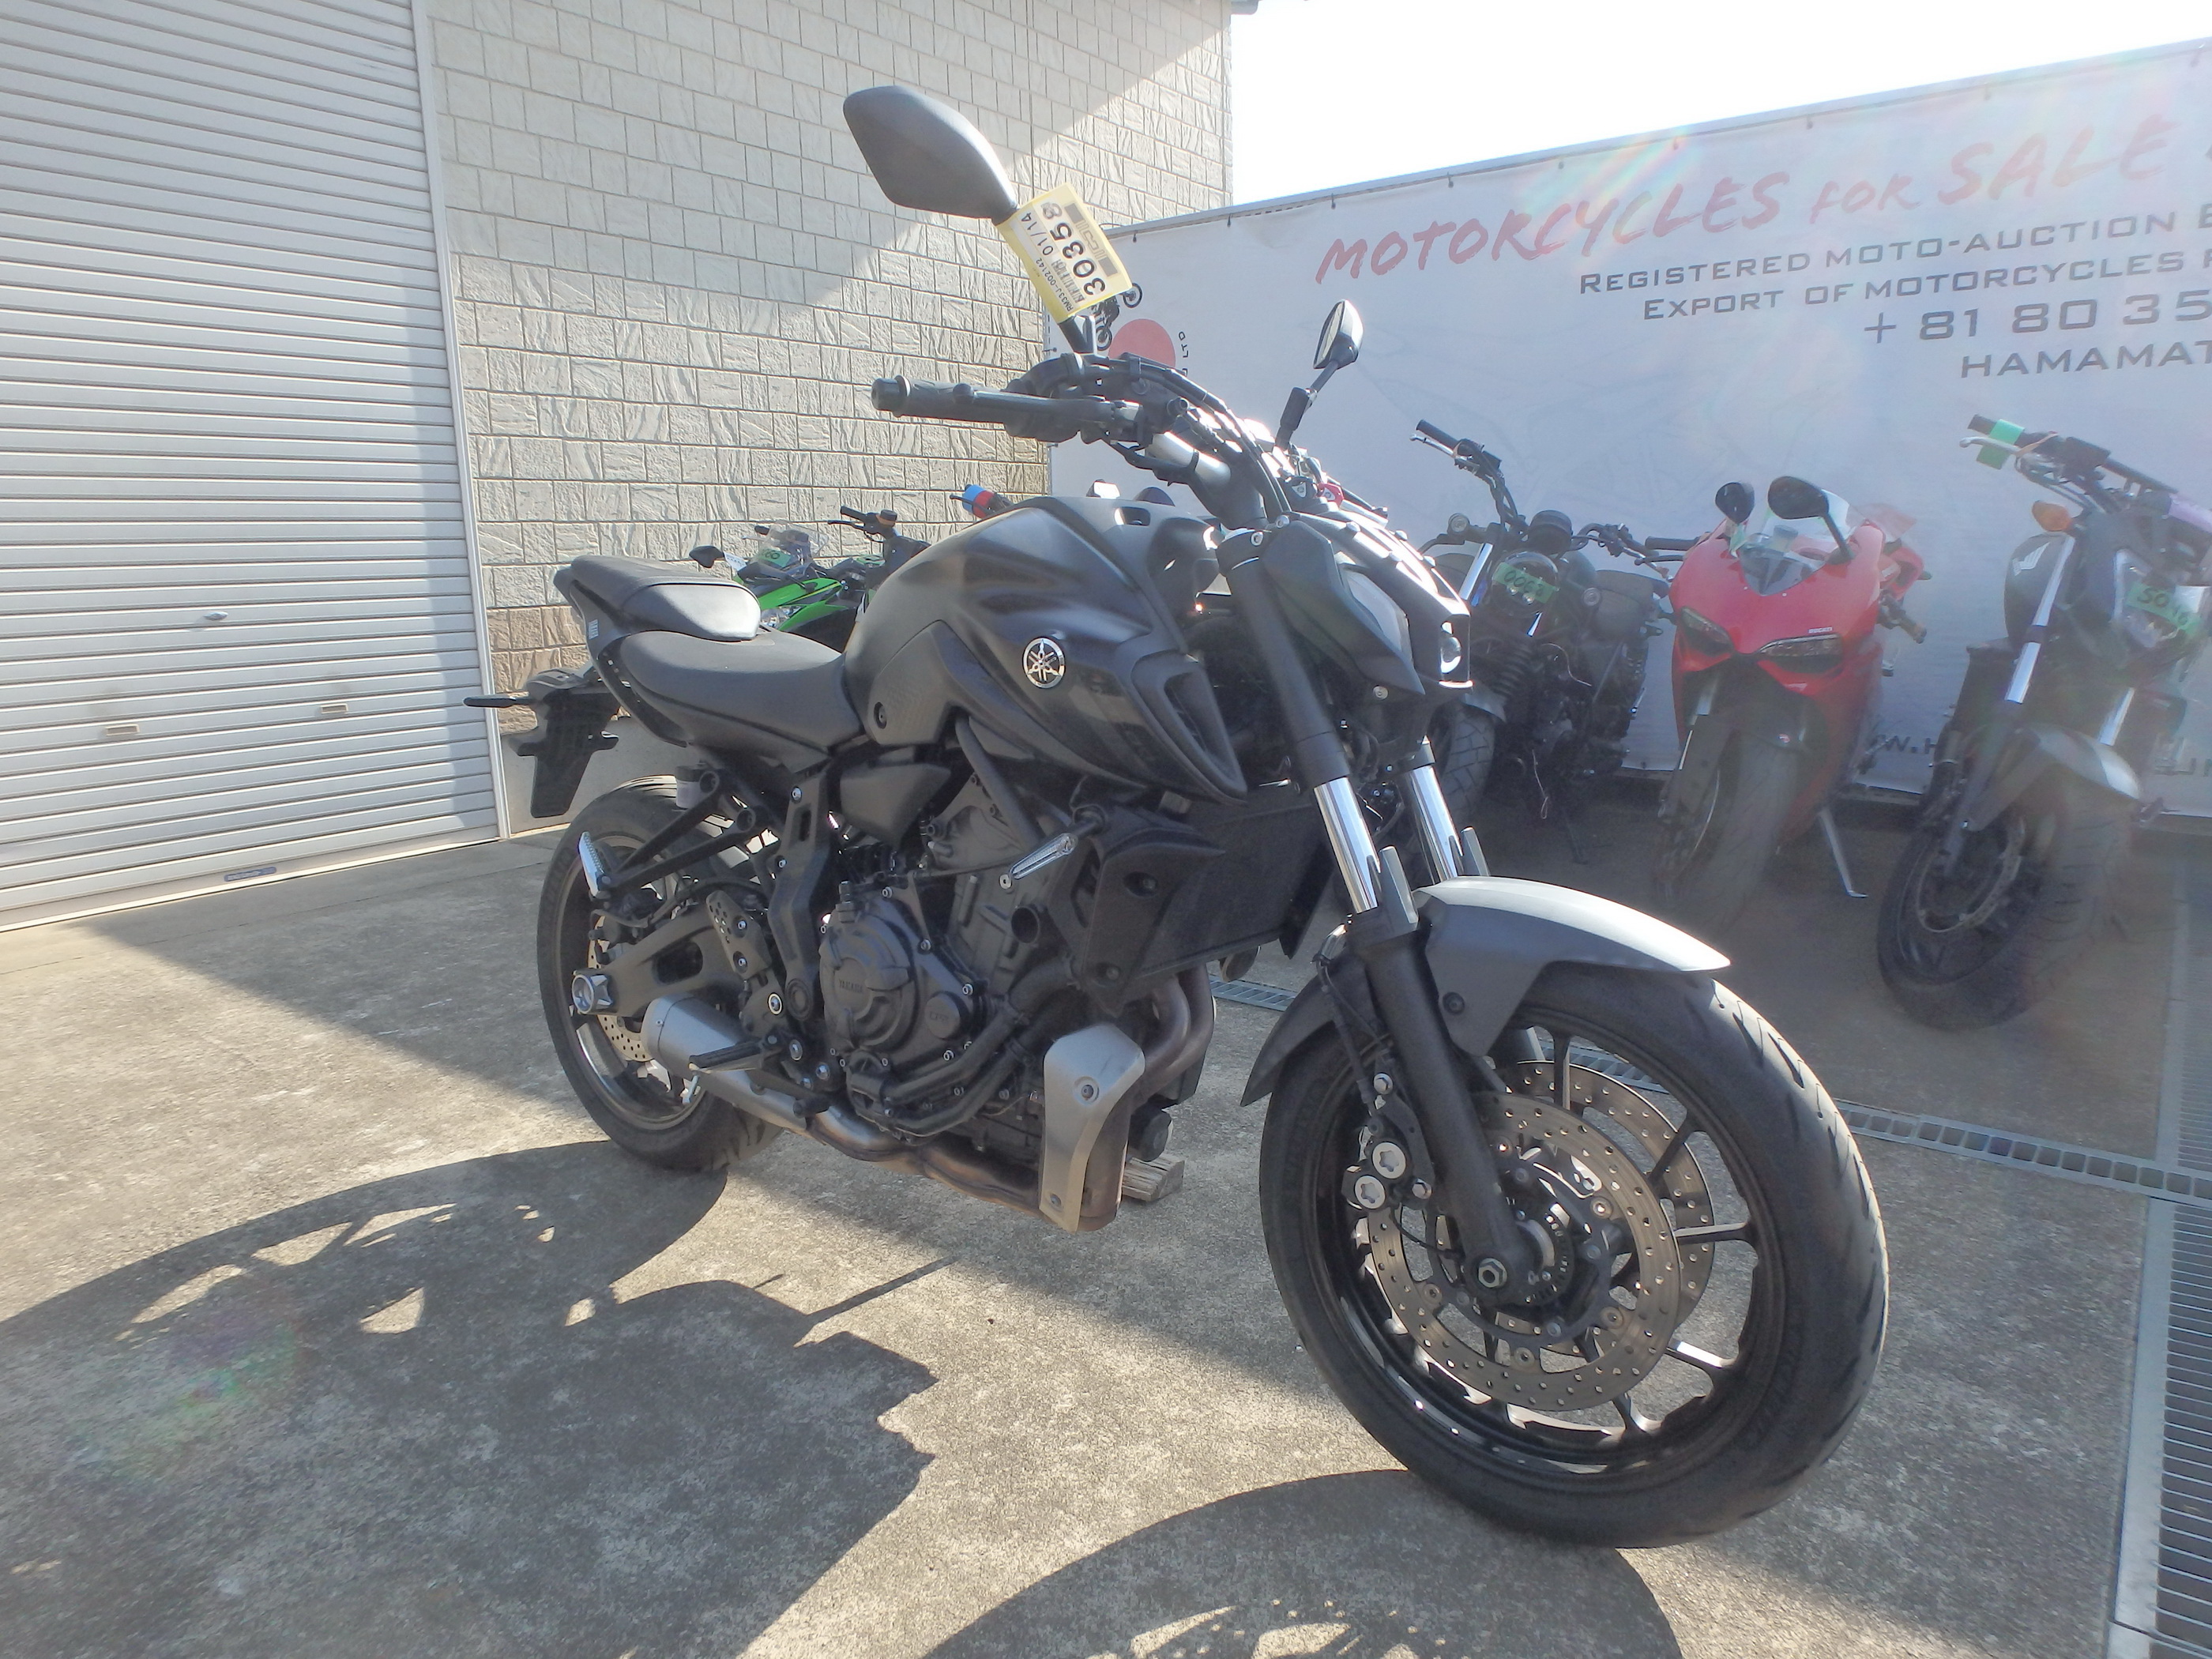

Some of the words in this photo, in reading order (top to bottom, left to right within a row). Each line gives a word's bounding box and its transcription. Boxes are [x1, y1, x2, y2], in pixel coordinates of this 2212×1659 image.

[1315, 171, 1790, 285] MOTORCYCLES
[1938, 113, 2180, 205] SALE
[1021, 212, 1054, 256] 01/14
[1580, 252, 1810, 295] REGISTERED
[1826, 212, 2175, 269] MOTO-AUCTION
[1036, 258, 1074, 312] RM33J-002142
[1644, 289, 1784, 321] EXPORT
[1804, 283, 1854, 306] OF
[1864, 251, 2184, 300] MOTORCYCLES
[1178, 330, 1189, 359] LTD
[1864, 312, 1896, 344] +
[1919, 307, 1979, 341] 81
[2011, 299, 2098, 334] 80
